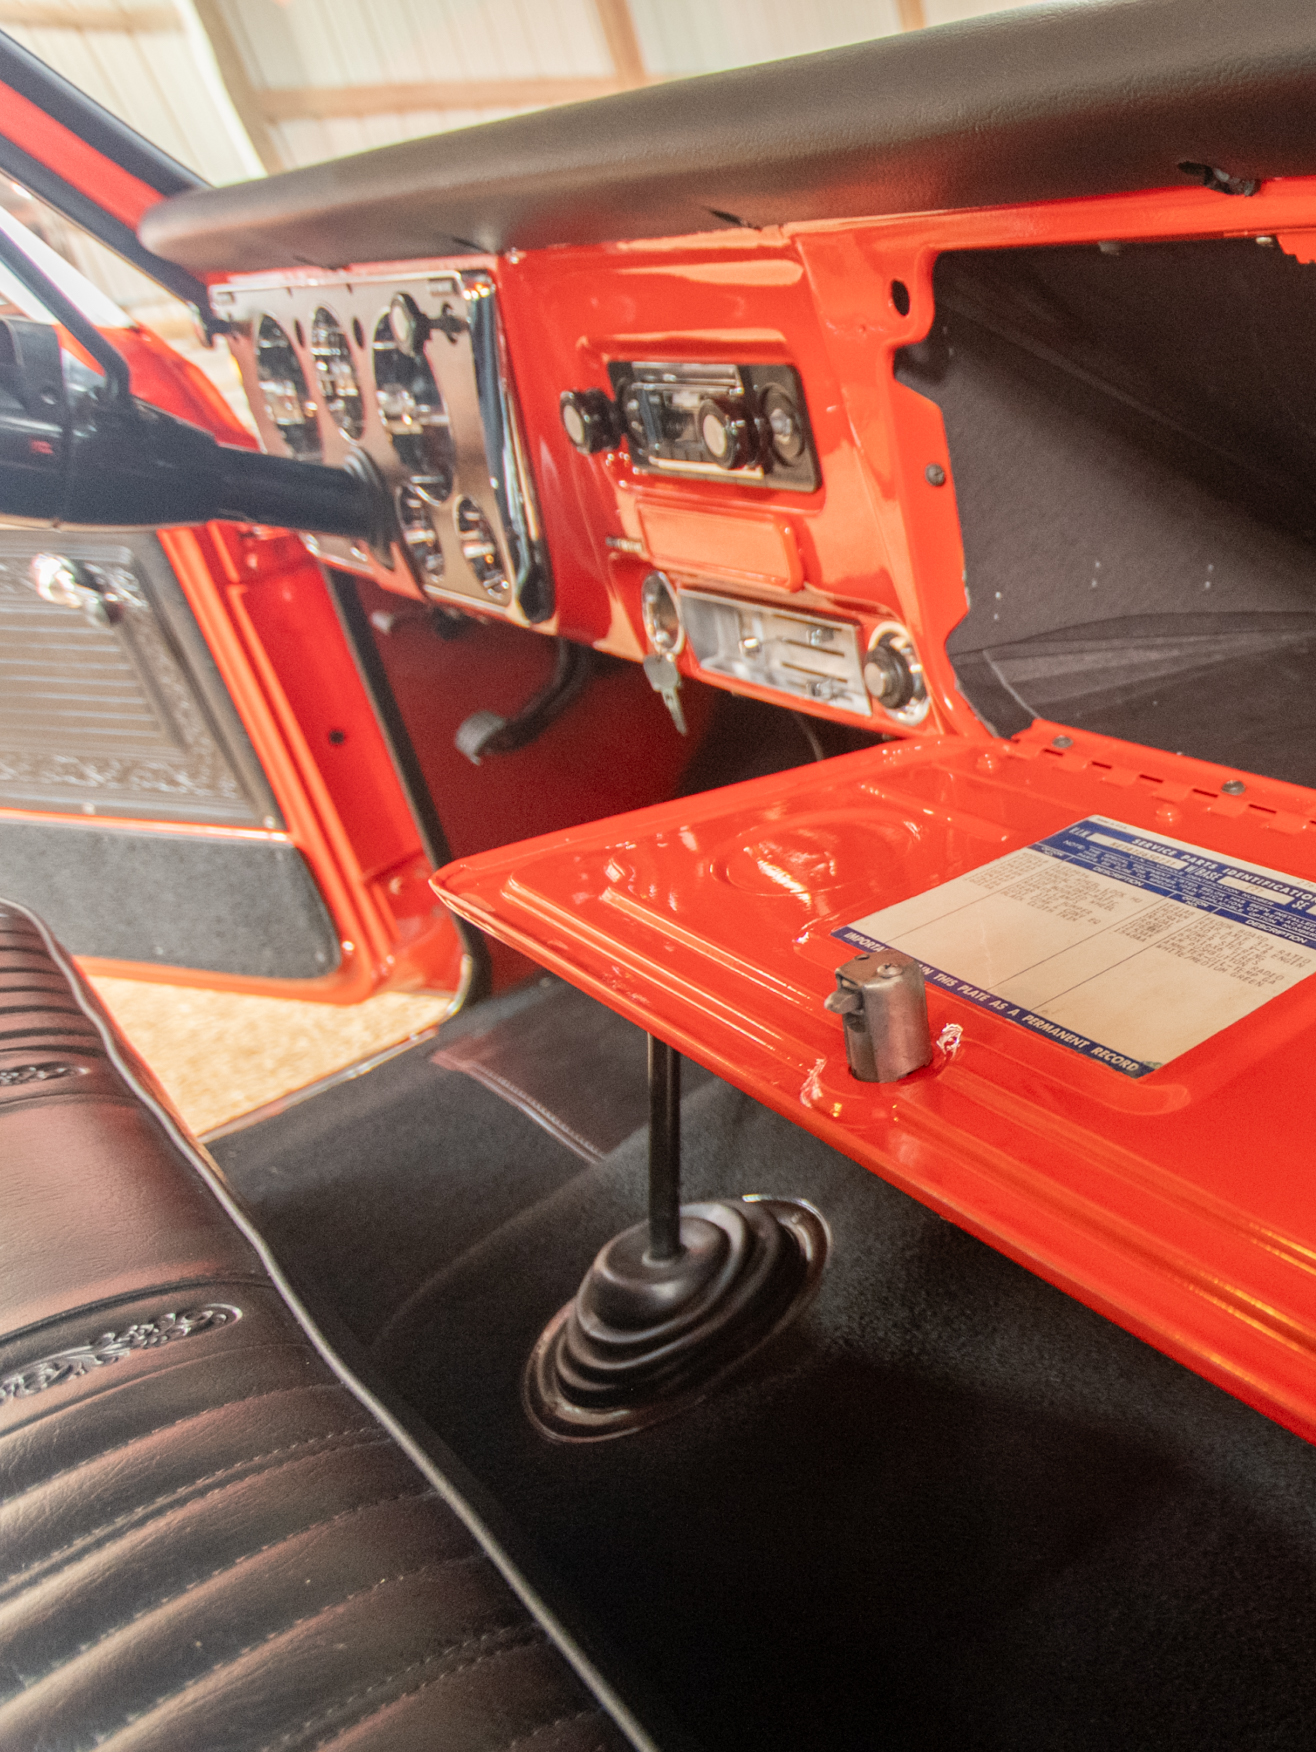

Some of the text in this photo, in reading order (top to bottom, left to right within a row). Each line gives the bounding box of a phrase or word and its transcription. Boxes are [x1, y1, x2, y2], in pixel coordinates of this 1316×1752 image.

[1129, 838, 1179, 856] SERVICE
[1178, 854, 1220, 869] PARTS
[1090, 866, 1146, 886] DESCRIPTION
[1130, 863, 1172, 878] EQUIPMENT
[1103, 887, 1128, 897] LOCK
[1177, 883, 1245, 907] IDENTIFICATION
[1181, 864, 1224, 880] W/BASE
[1290, 899, 1312, 909] SE
[1184, 874, 1241, 893] IDENTIFICATION
[1026, 901, 1055, 913] CLOTH
[1199, 895, 1245, 912] APPLICABLE
[1196, 920, 1222, 931] REAR
[1224, 930, 1251, 941] AXLE
[1277, 949, 1312, 963] RATIO
[1203, 917, 1235, 929] FLOOR
[1236, 929, 1270, 942] BOARD
[1243, 919, 1308, 943] DESCRIPTION
[1182, 928, 1215, 941] POWER
[1217, 941, 1268, 961] STEERING
[1189, 924, 1211, 934] 350
[1211, 932, 1228, 940] CU
[1270, 953, 1306, 968] ENGIN
[1154, 943, 1228, 973] WHITE/MEDIUM
[1228, 972, 1265, 987] GREEN
[1185, 942, 1248, 966] PUSHBUTTON
[1250, 966, 1285, 980] RADIO
[1227, 951, 1262, 965] TIRES
[1261, 977, 1278, 985] GA
[842, 932, 1142, 1071] IMPORTA THIS PLATE AS A PERMANENT RECORD
